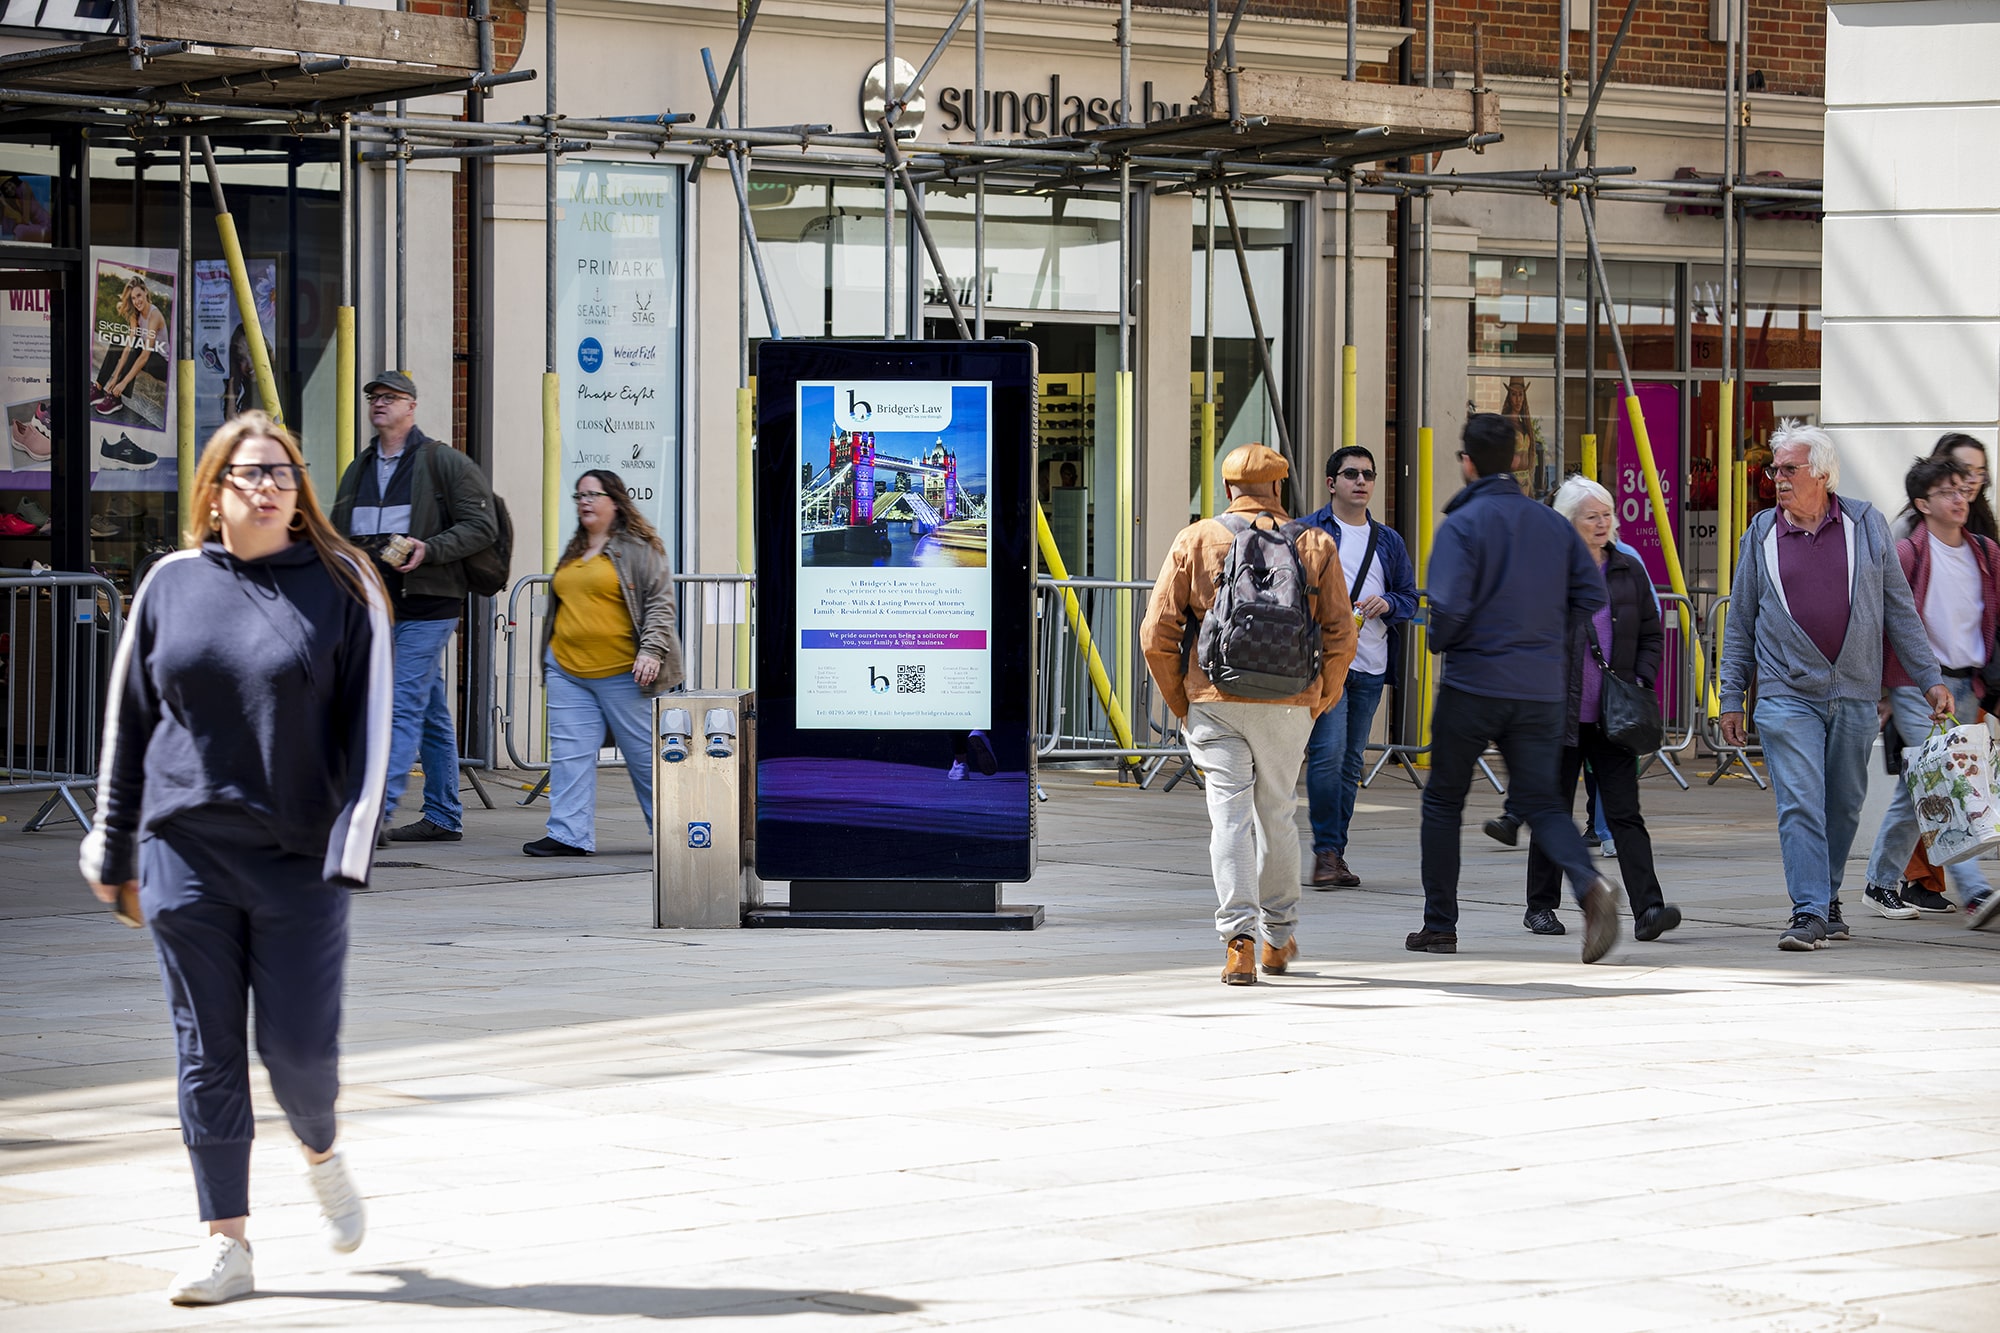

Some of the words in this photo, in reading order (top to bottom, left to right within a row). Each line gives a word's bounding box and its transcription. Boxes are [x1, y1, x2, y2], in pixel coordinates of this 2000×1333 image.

[569, 184, 664, 208] MARLOWE
[580, 212, 654, 234] ARCADE
[578, 259, 654, 277] PRIMARK
[577, 305, 617, 318] SEASALT
[632, 312, 655, 323] STAG
[98, 320, 157, 339] SKECHERS
[614, 344, 639, 359] Weird
[639, 345, 656, 360] Fish
[1695, 342, 1710, 360] 15
[578, 384, 617, 401] Phase
[620, 385, 655, 406] Eight
[877, 404, 919, 415] Bridger's
[922, 404, 942, 413] Law
[621, 460, 655, 469] SWAROVSKI
[1636, 527, 1658, 535] LINGE
[860, 580, 891, 588] Bridger's
[814, 608, 835, 616] Family
[928, 608, 975, 617] Conveyancing
